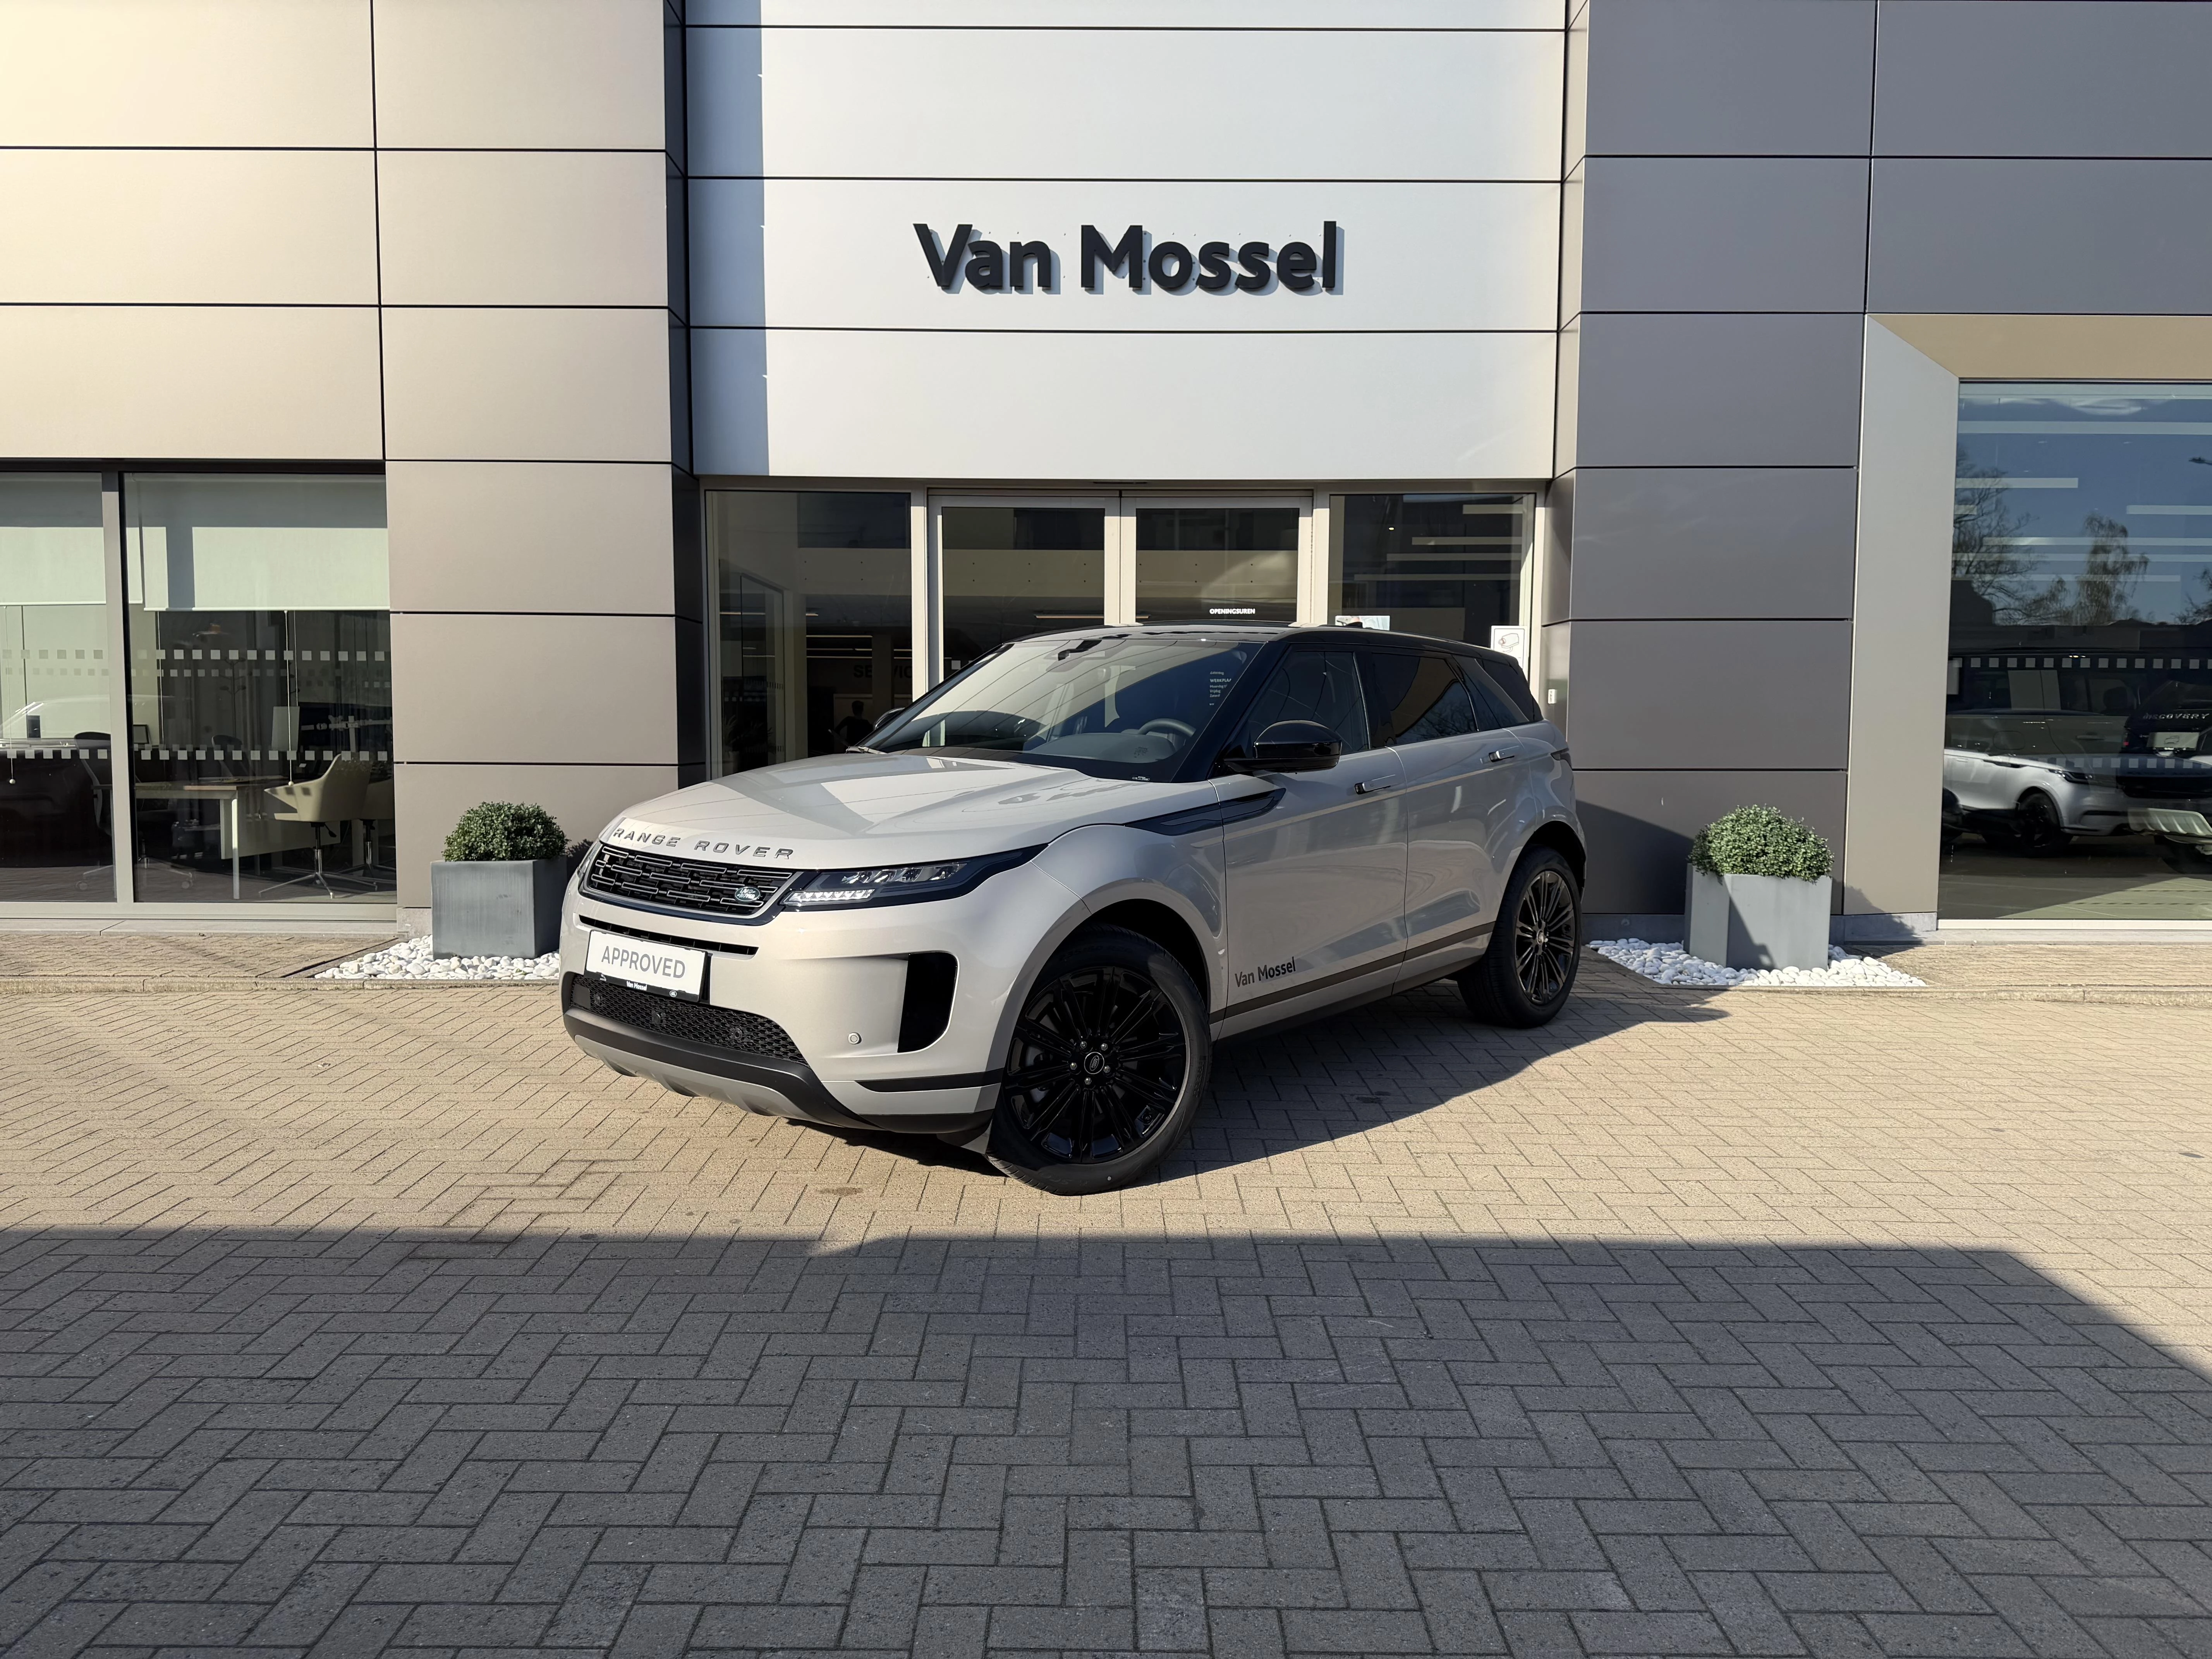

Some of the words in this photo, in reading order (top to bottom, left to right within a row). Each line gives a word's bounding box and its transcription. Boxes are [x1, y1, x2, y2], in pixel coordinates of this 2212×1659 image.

[913, 223, 1051, 288] Van
[1080, 221, 1337, 288] Mossel
[613, 828, 681, 847] RANGE
[694, 840, 794, 859] ROVER
[601, 946, 685, 979] APPROVED
[1235, 971, 1255, 987] Van
[1257, 956, 1296, 981] Mossel
[634, 982, 647, 991] Mossel
